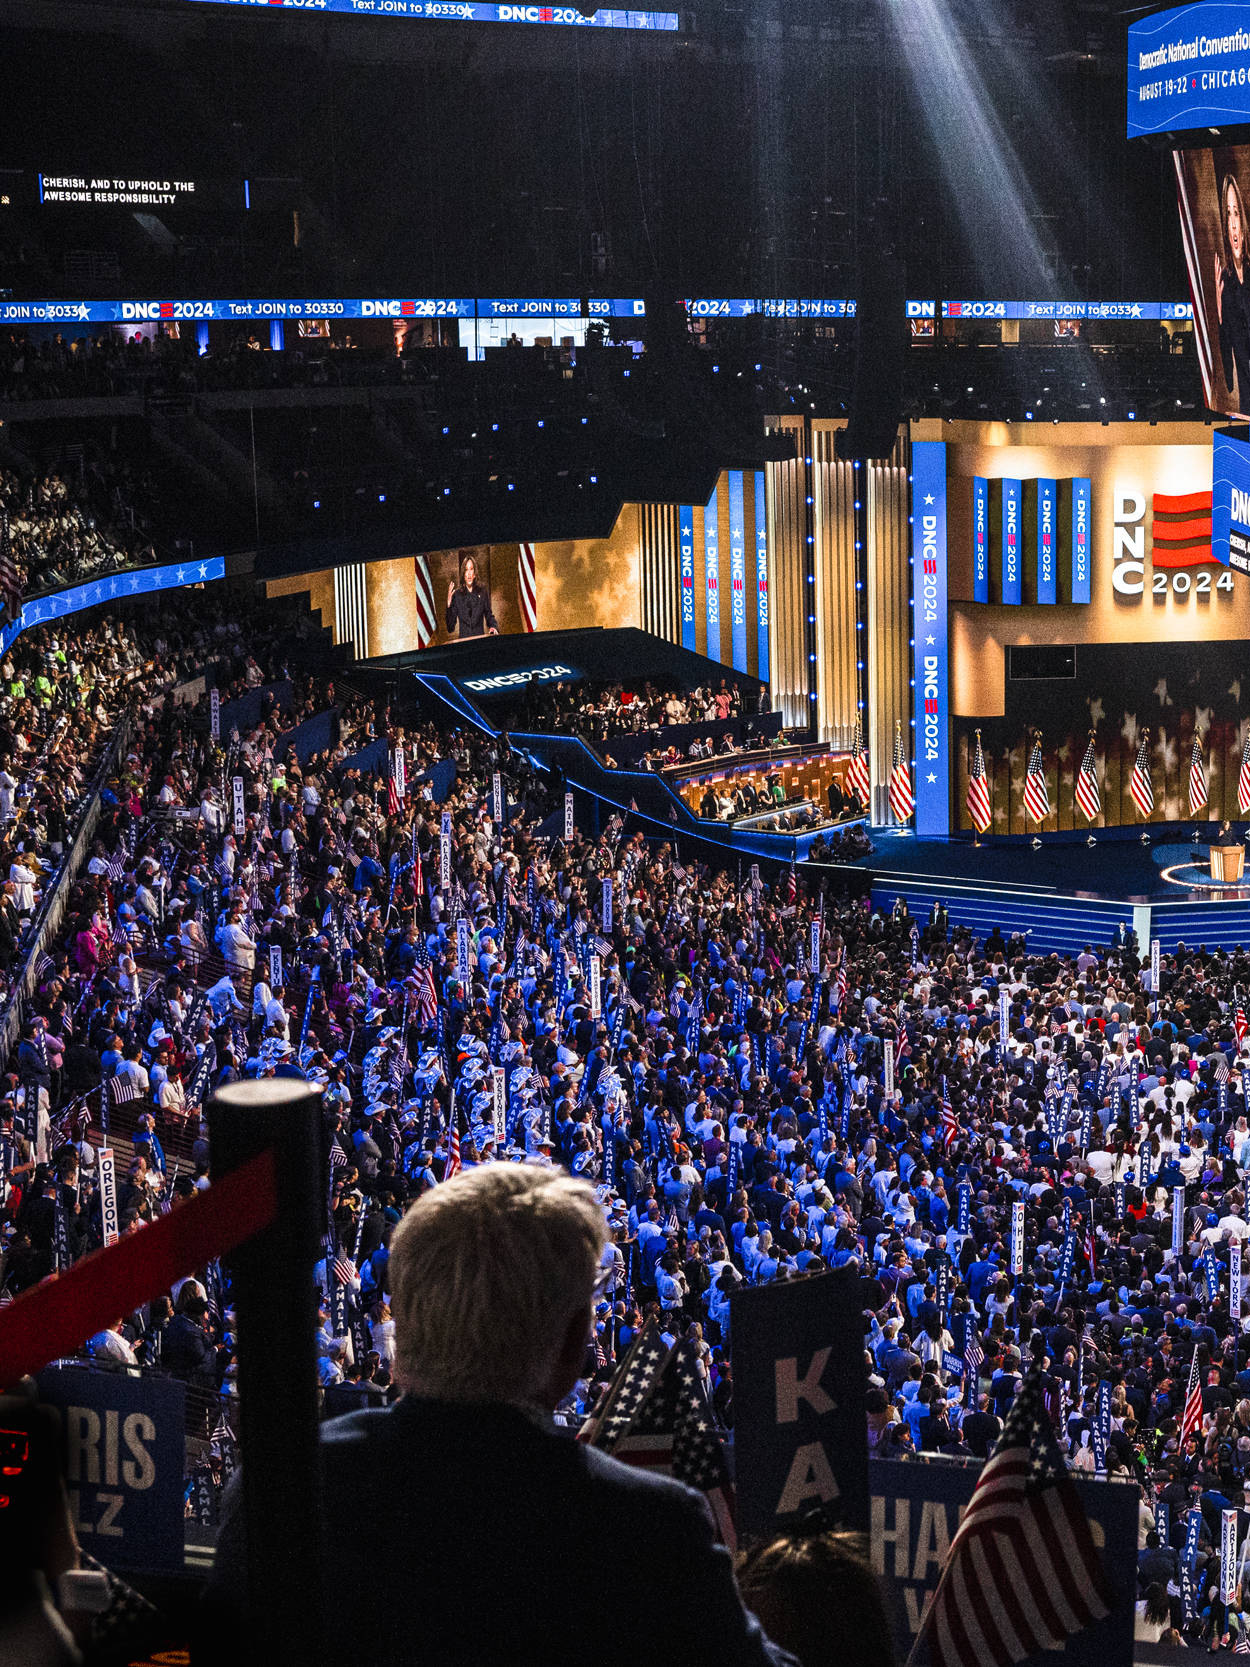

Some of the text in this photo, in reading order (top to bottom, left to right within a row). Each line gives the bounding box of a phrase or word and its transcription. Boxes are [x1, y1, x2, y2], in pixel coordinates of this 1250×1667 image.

[353, 0, 464, 15] Text JOIN to 30330
[500, 6, 539, 21] DNC
[1139, 43, 1168, 71] Democratic
[1168, 36, 1198, 62] National
[1139, 82, 1162, 101] AUGUST
[1165, 76, 1187, 96] 19-22
[43, 178, 195, 191] CHERISH, AND TO UPHOLD THE
[44, 191, 176, 204] AWESOME RESPONSIBILITY
[3, 306, 45, 318] JOIN to
[122, 303, 214, 318] DNC 2024
[229, 303, 343, 315] Text JOIN to 30330
[362, 301, 457, 316] DNC 2024
[492, 302, 567, 312] Text JOIN to
[962, 303, 1006, 316] 2024
[1029, 305, 1099, 315] Text JOIN to
[1007, 500, 1016, 582] DNC 2024
[1042, 500, 1051, 582] DNC 2024
[682, 545, 693, 622] DNC 2024
[707, 547, 718, 624] DNC 2024
[732, 548, 743, 625] DNC 2024
[922, 516, 937, 622] DNC 2024
[1151, 572, 1234, 593] 2024
[759, 591, 768, 626] 2024
[924, 656, 939, 761] DNC 2024
[234, 784, 244, 826] UTAH
[729, 1146, 737, 1188] KAMALA
[102, 1160, 116, 1233] OREGON
[1061, 1236, 1073, 1277] KAMALA
[1207, 1254, 1217, 1295] KAMALA
[67, 1406, 156, 1490] RIS
[70, 1492, 124, 1537] LZ
